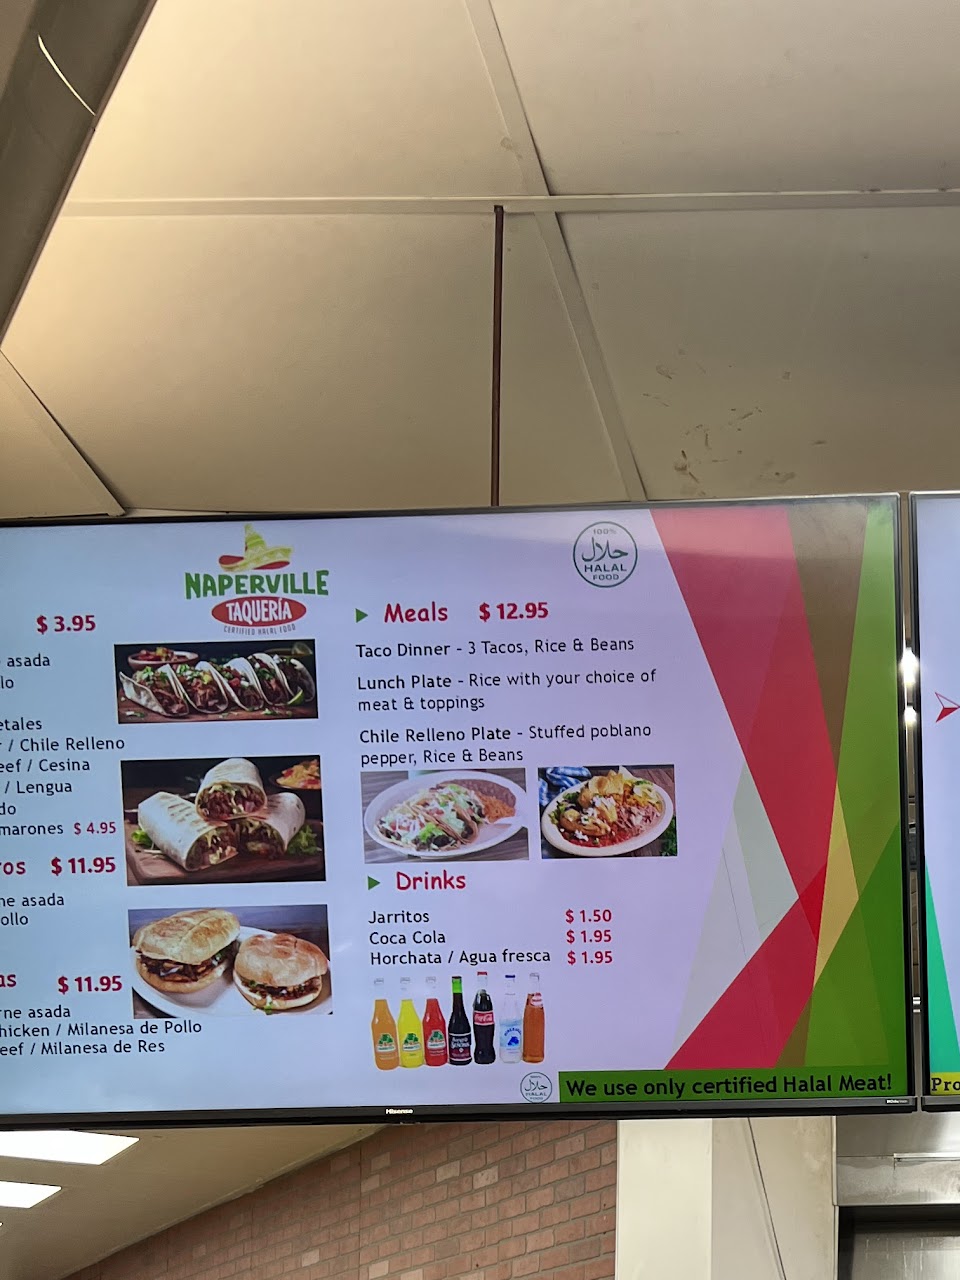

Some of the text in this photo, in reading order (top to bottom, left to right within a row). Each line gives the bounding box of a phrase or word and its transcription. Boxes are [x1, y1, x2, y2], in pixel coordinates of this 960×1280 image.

[581, 536, 629, 562] حلال
[584, 563, 627, 573] HALAL
[185, 569, 330, 600] NAPERVILLE
[226, 598, 292, 625] TAQUERÍA
[384, 602, 448, 624] Meals
[223, 624, 296, 637] CERTIFIED HALAL FOOD
[356, 638, 634, 658] Taco Dinner 3 Tacos, Rice & Beans
[7, 653, 50, 667] asada
[357, 668, 657, 690] Lunch Plate Rice with your choice of
[358, 695, 485, 713] meat & toppings
[359, 723, 652, 744] Chile Relleno Plate Stuffed poblano
[20, 736, 125, 751] Chile Relleno
[39, 759, 90, 772] Cesina
[361, 748, 524, 768] pepper, Rice & Beans
[17, 781, 73, 796] Lengua
[396, 870, 466, 890] Drinks
[22, 893, 65, 906] asada
[368, 910, 430, 925] Jarritos
[369, 931, 406, 945] Coca
[412, 930, 446, 944] Cola
[371, 951, 442, 965] Horchata
[459, 950, 497, 966] Agua
[502, 949, 551, 963] fresca
[28, 1005, 71, 1018] asada
[67, 1022, 134, 1036] Milanesa
[140, 1021, 158, 1034] de
[165, 1020, 202, 1033] Pollo
[41, 1041, 108, 1055] Milanesa
[113, 1040, 132, 1053] de
[138, 1039, 165, 1053] Res
[566, 1073, 892, 1099] We use only certified Halal Meat!
